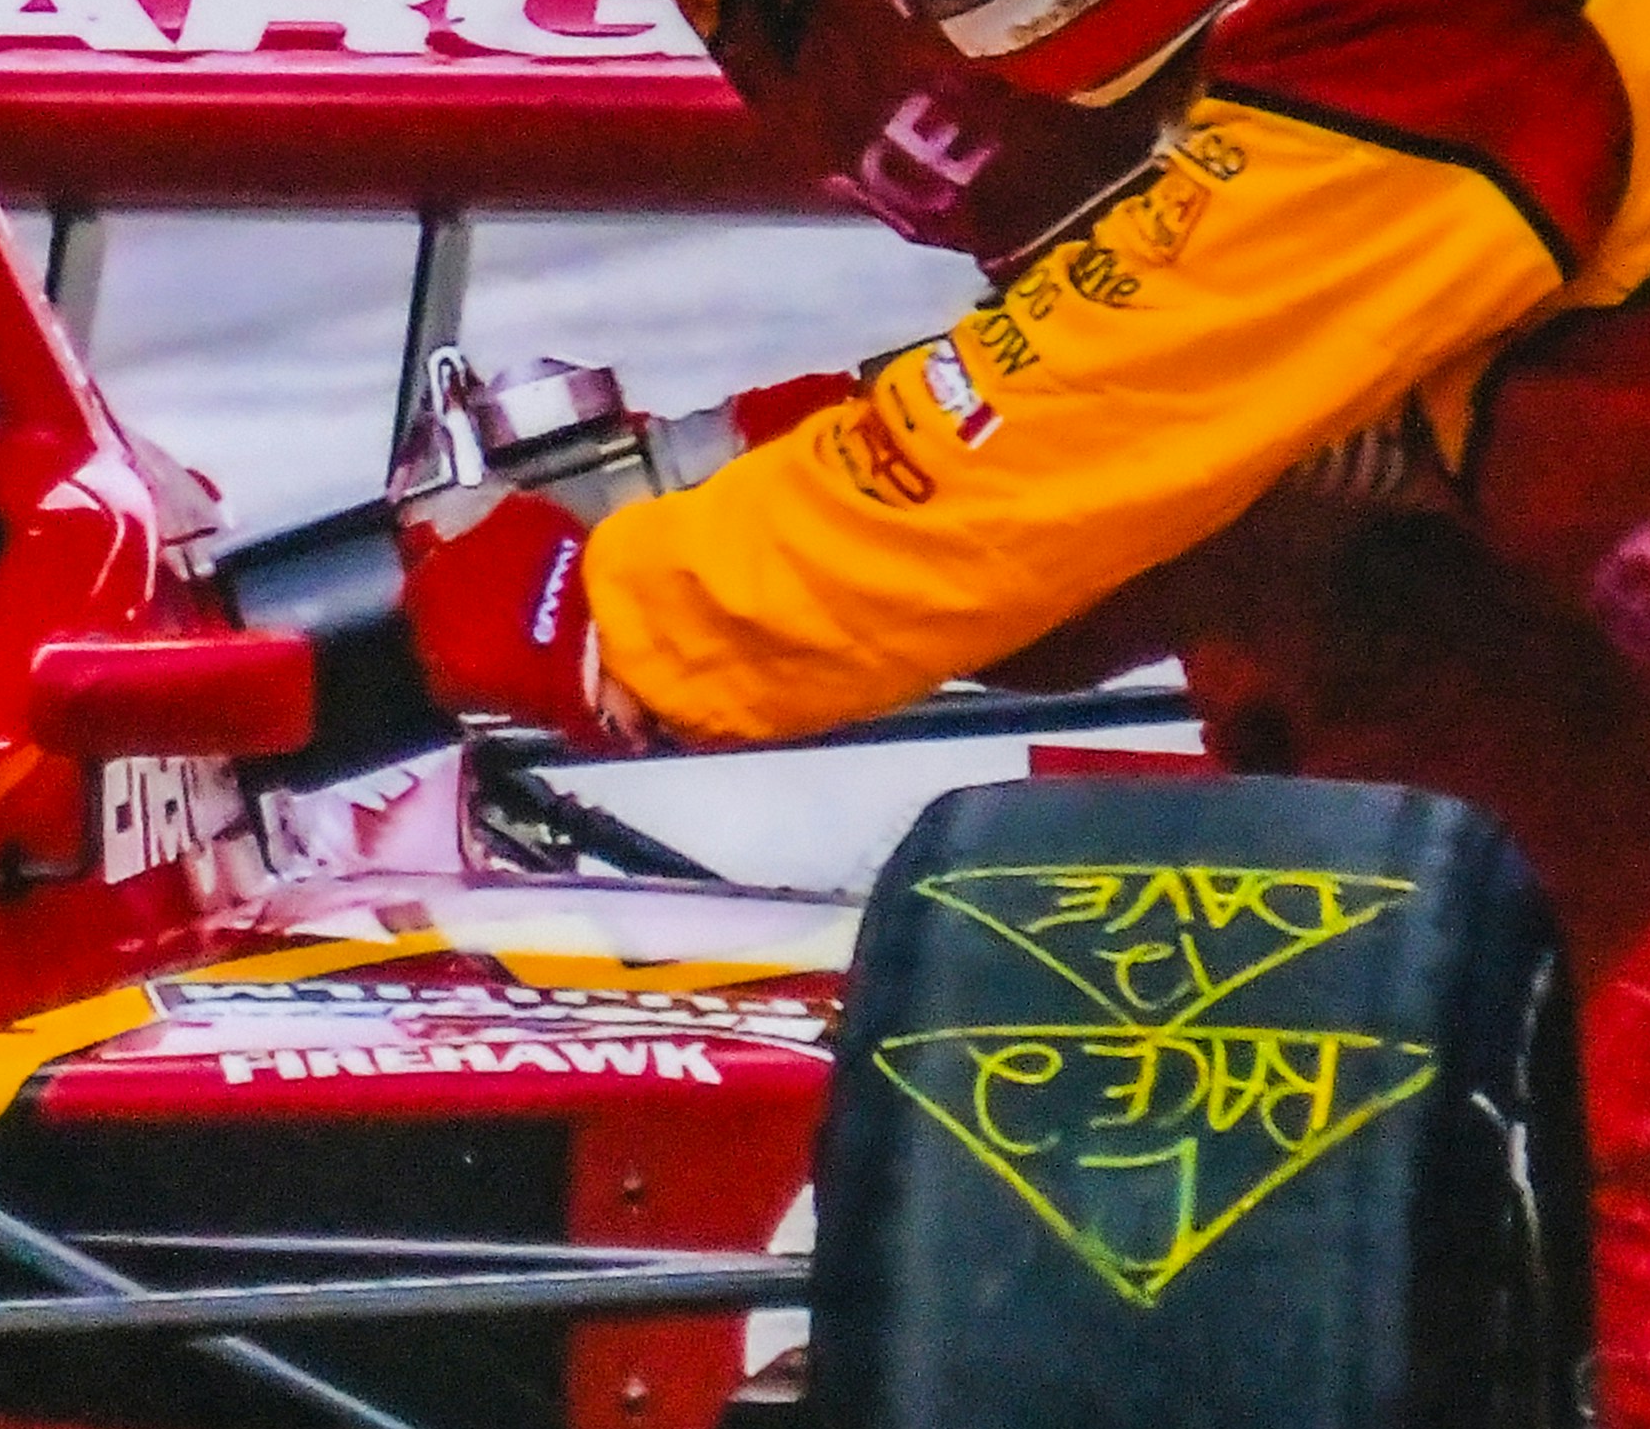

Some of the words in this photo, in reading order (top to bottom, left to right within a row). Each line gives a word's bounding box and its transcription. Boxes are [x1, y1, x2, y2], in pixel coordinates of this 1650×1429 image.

[1017, 864, 1346, 937] DAVE
[218, 1040, 723, 1085] FIREHAWK
[1080, 1033, 1338, 1151] RACE
